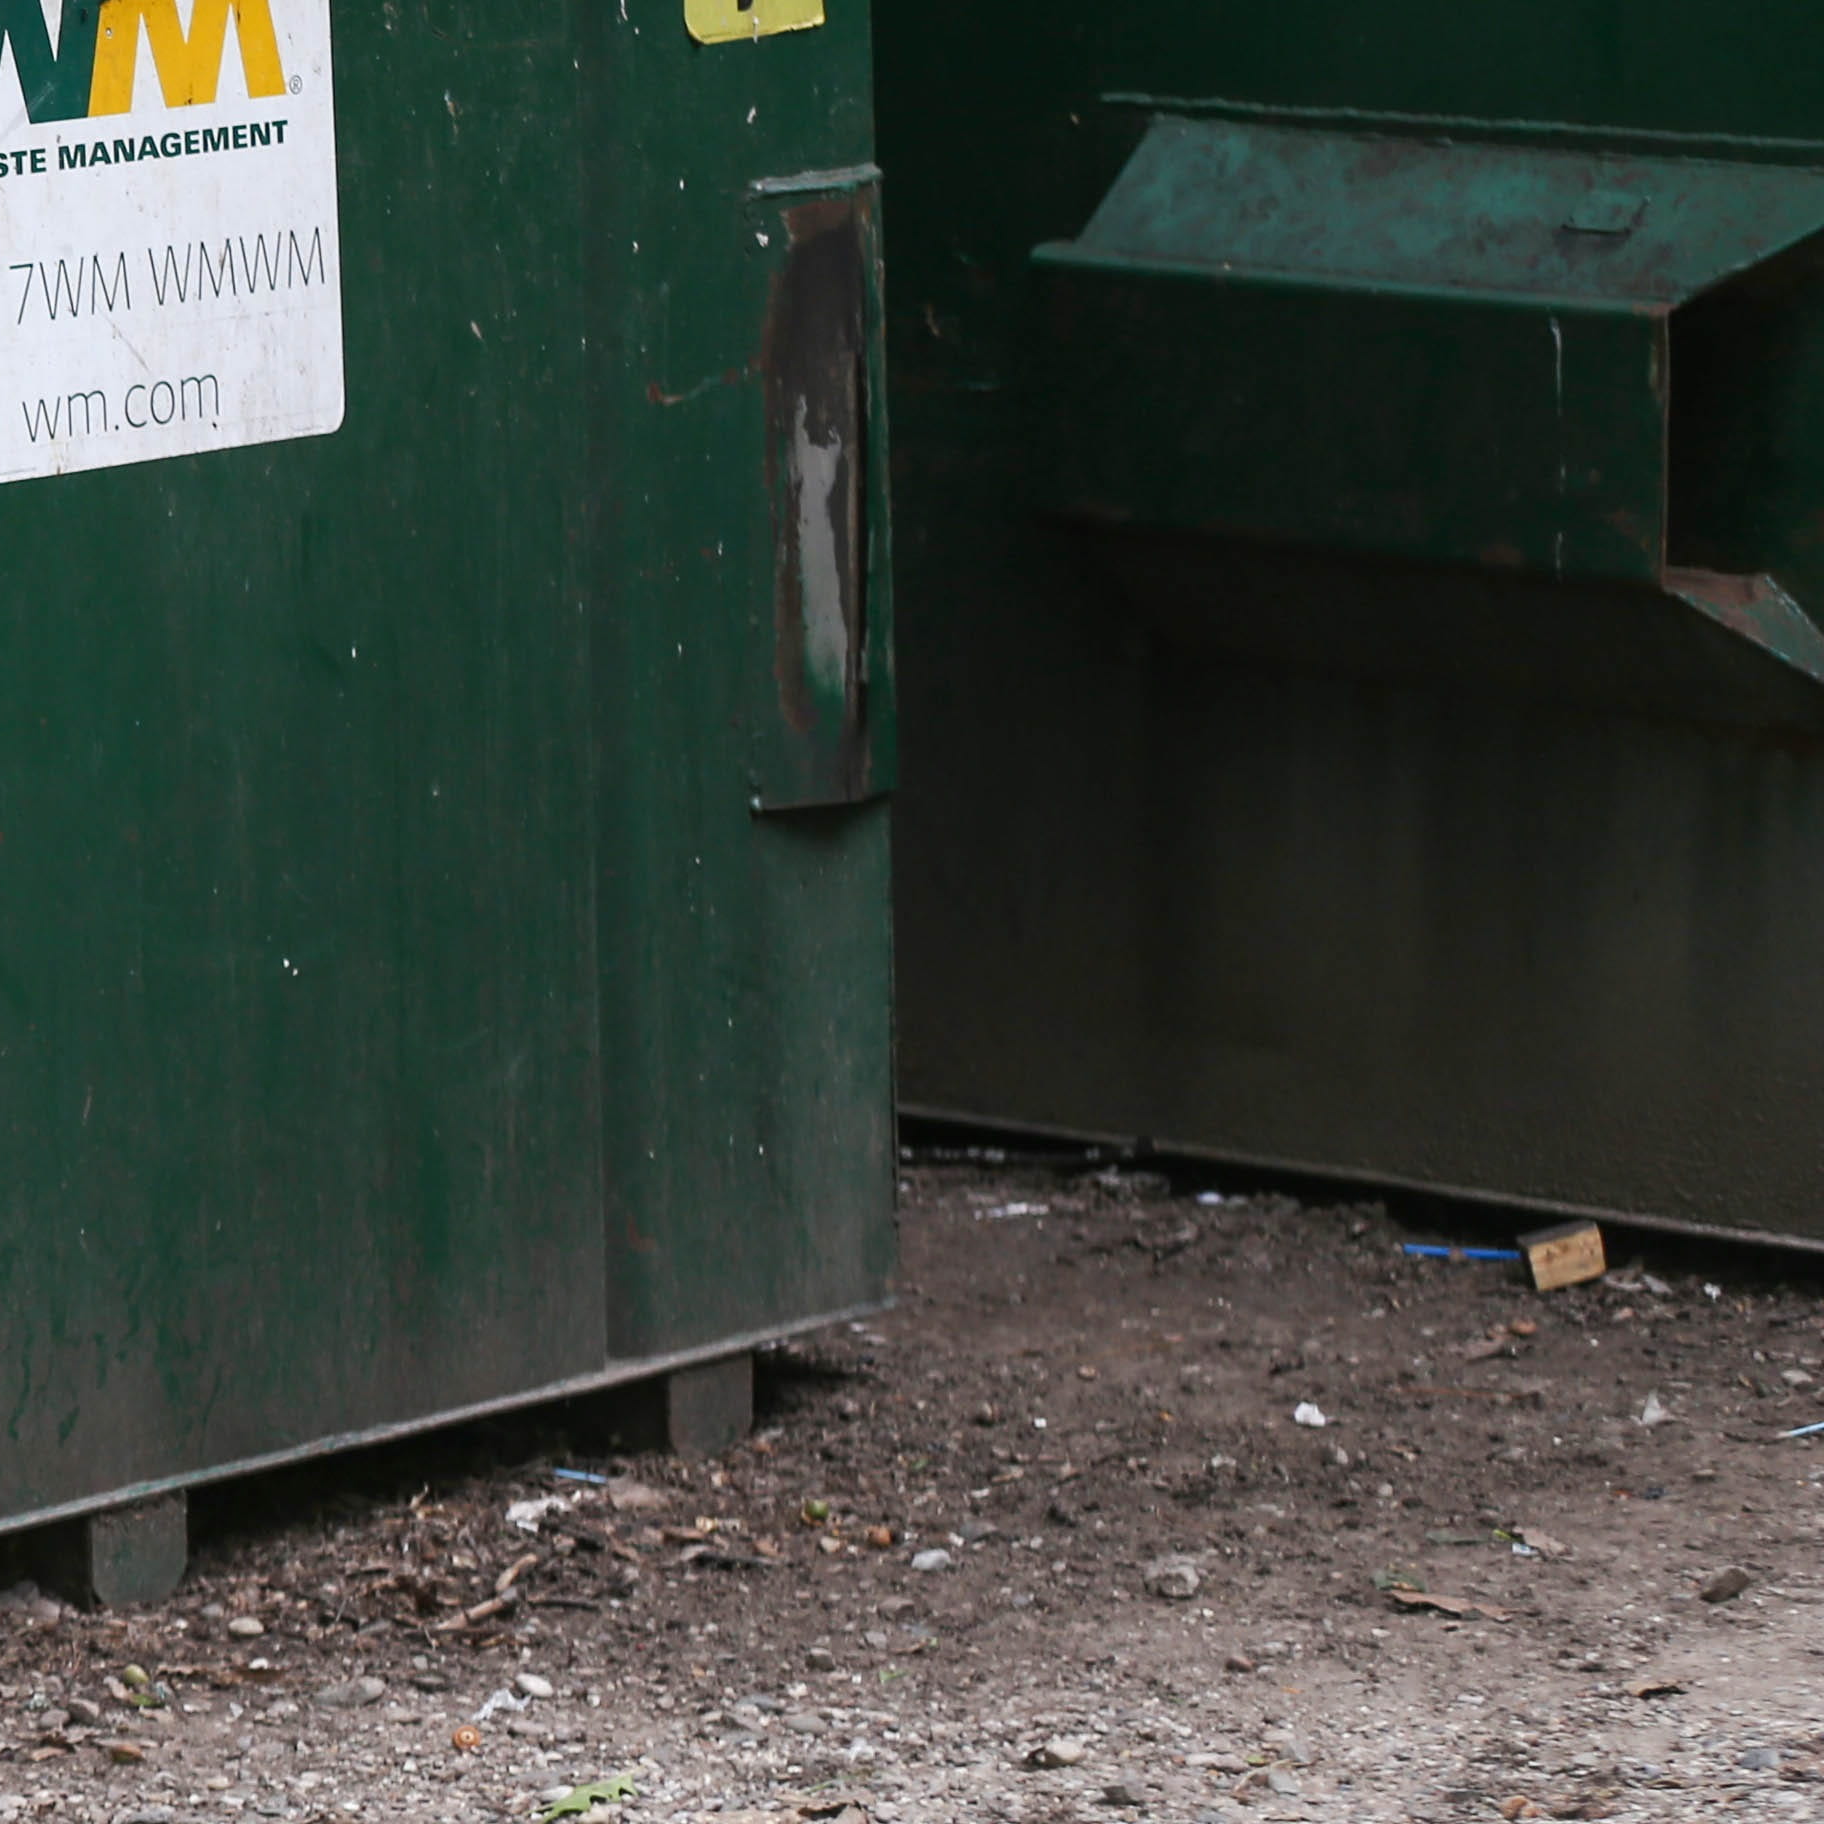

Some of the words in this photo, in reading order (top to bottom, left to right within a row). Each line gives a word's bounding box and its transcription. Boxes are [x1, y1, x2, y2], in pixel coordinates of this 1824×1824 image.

[57, 120, 288, 170] MANAGEMENT
[9, 251, 131, 326] 7WM
[148, 226, 326, 307] WMWM
[22, 374, 221, 443] wm.com
